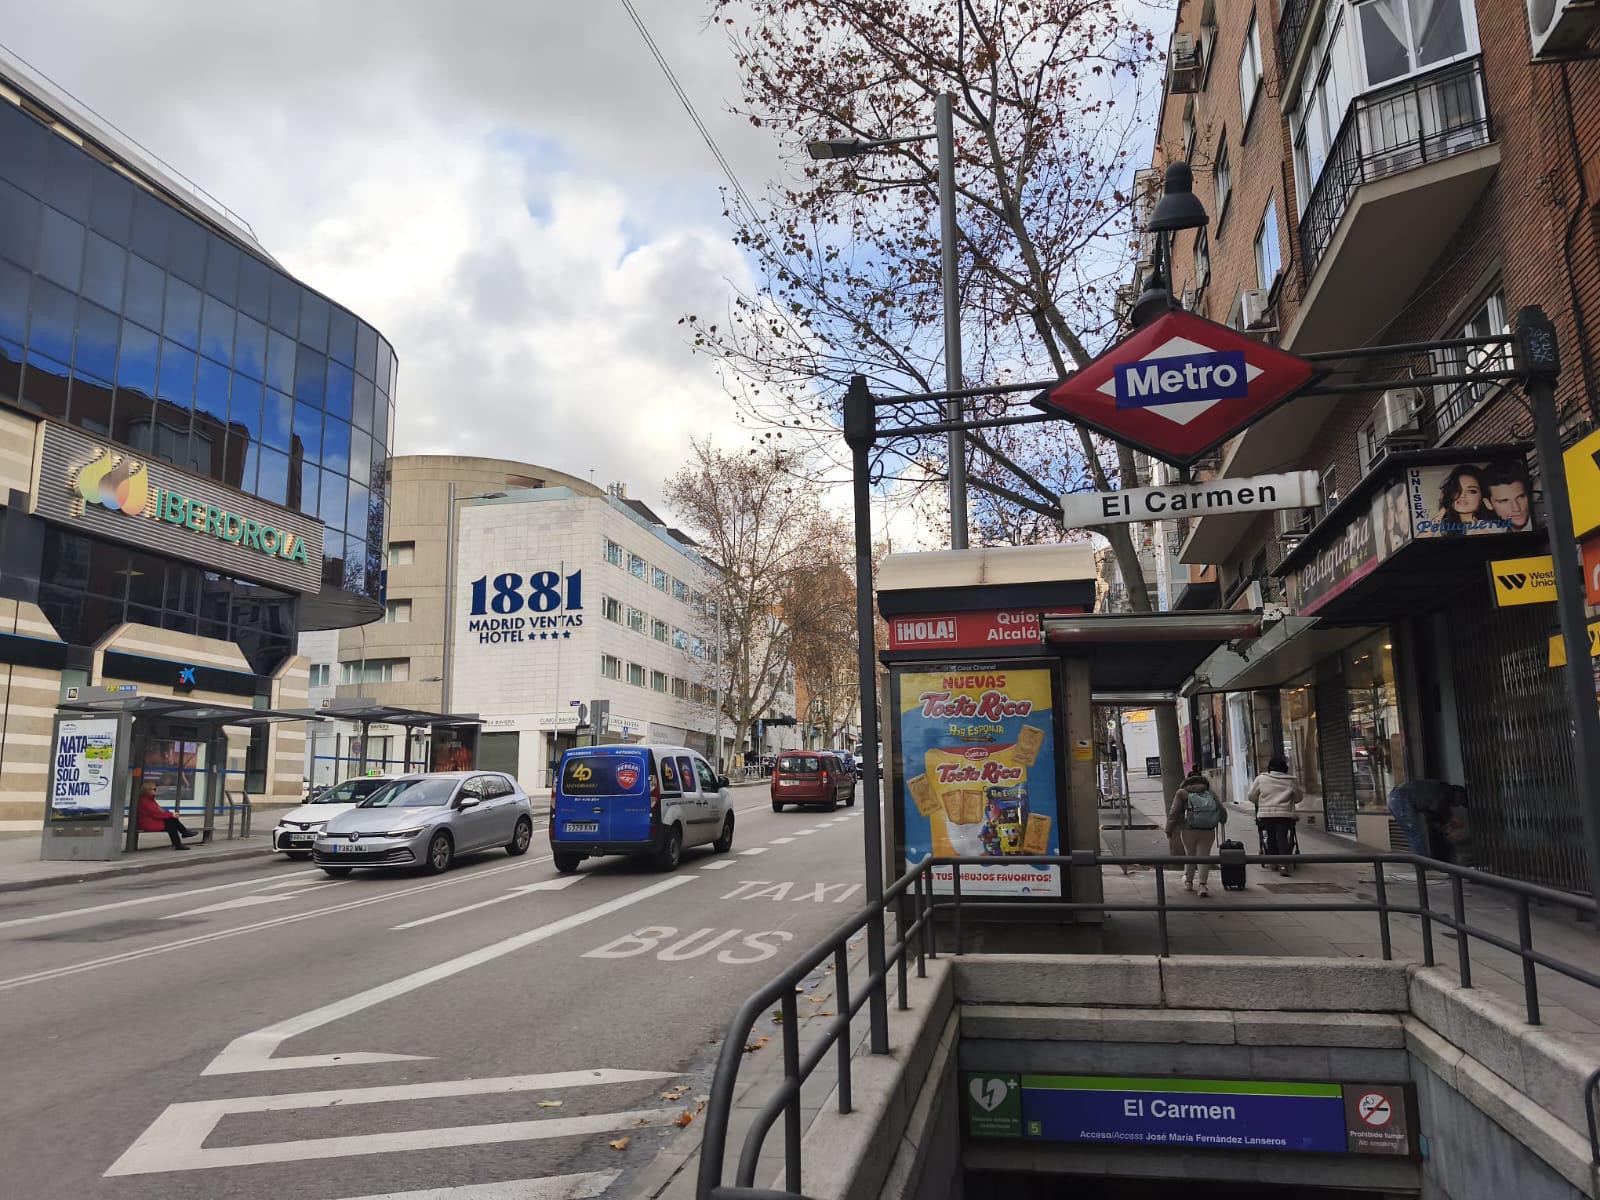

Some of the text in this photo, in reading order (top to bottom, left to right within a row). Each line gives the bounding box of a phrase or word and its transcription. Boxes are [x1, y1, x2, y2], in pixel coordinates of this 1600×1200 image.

[1126, 362, 1237, 397] Metro
[1102, 485, 1276, 517] El Carmen
[1410, 470, 1424, 519] UNISEX
[154, 486, 309, 566] IBERDROLA
[1528, 570, 1554, 579] West
[1530, 579, 1555, 588] Unio
[469, 568, 584, 616] 1881
[468, 614, 583, 632] MADRID VENTAS
[897, 620, 955, 642] ¡HOLA!
[479, 630, 524, 644] HOTEL
[942, 675, 1006, 689] NUEVAS
[919, 690, 1031, 721] Tosta Rica
[59, 735, 88, 754] NATA
[57, 754, 77, 769] QUE
[56, 768, 80, 782] SOLO
[937, 761, 1023, 784] Tosta Rica
[55, 782, 91, 796] ES NATA
[935, 872, 953, 881] TUS
[960, 873, 995, 881] IBUJOS
[996, 873, 1052, 882] FAVORITOS!
[719, 880, 864, 903] TAXI
[580, 926, 794, 964] BUS
[1123, 1099, 1236, 1120] El Carmen
[1031, 1122, 1039, 1133] 5
[1349, 1130, 1383, 1139] Prohibido
[1079, 1130, 1287, 1146] Acceso/Access José María Fernández Lanseros
